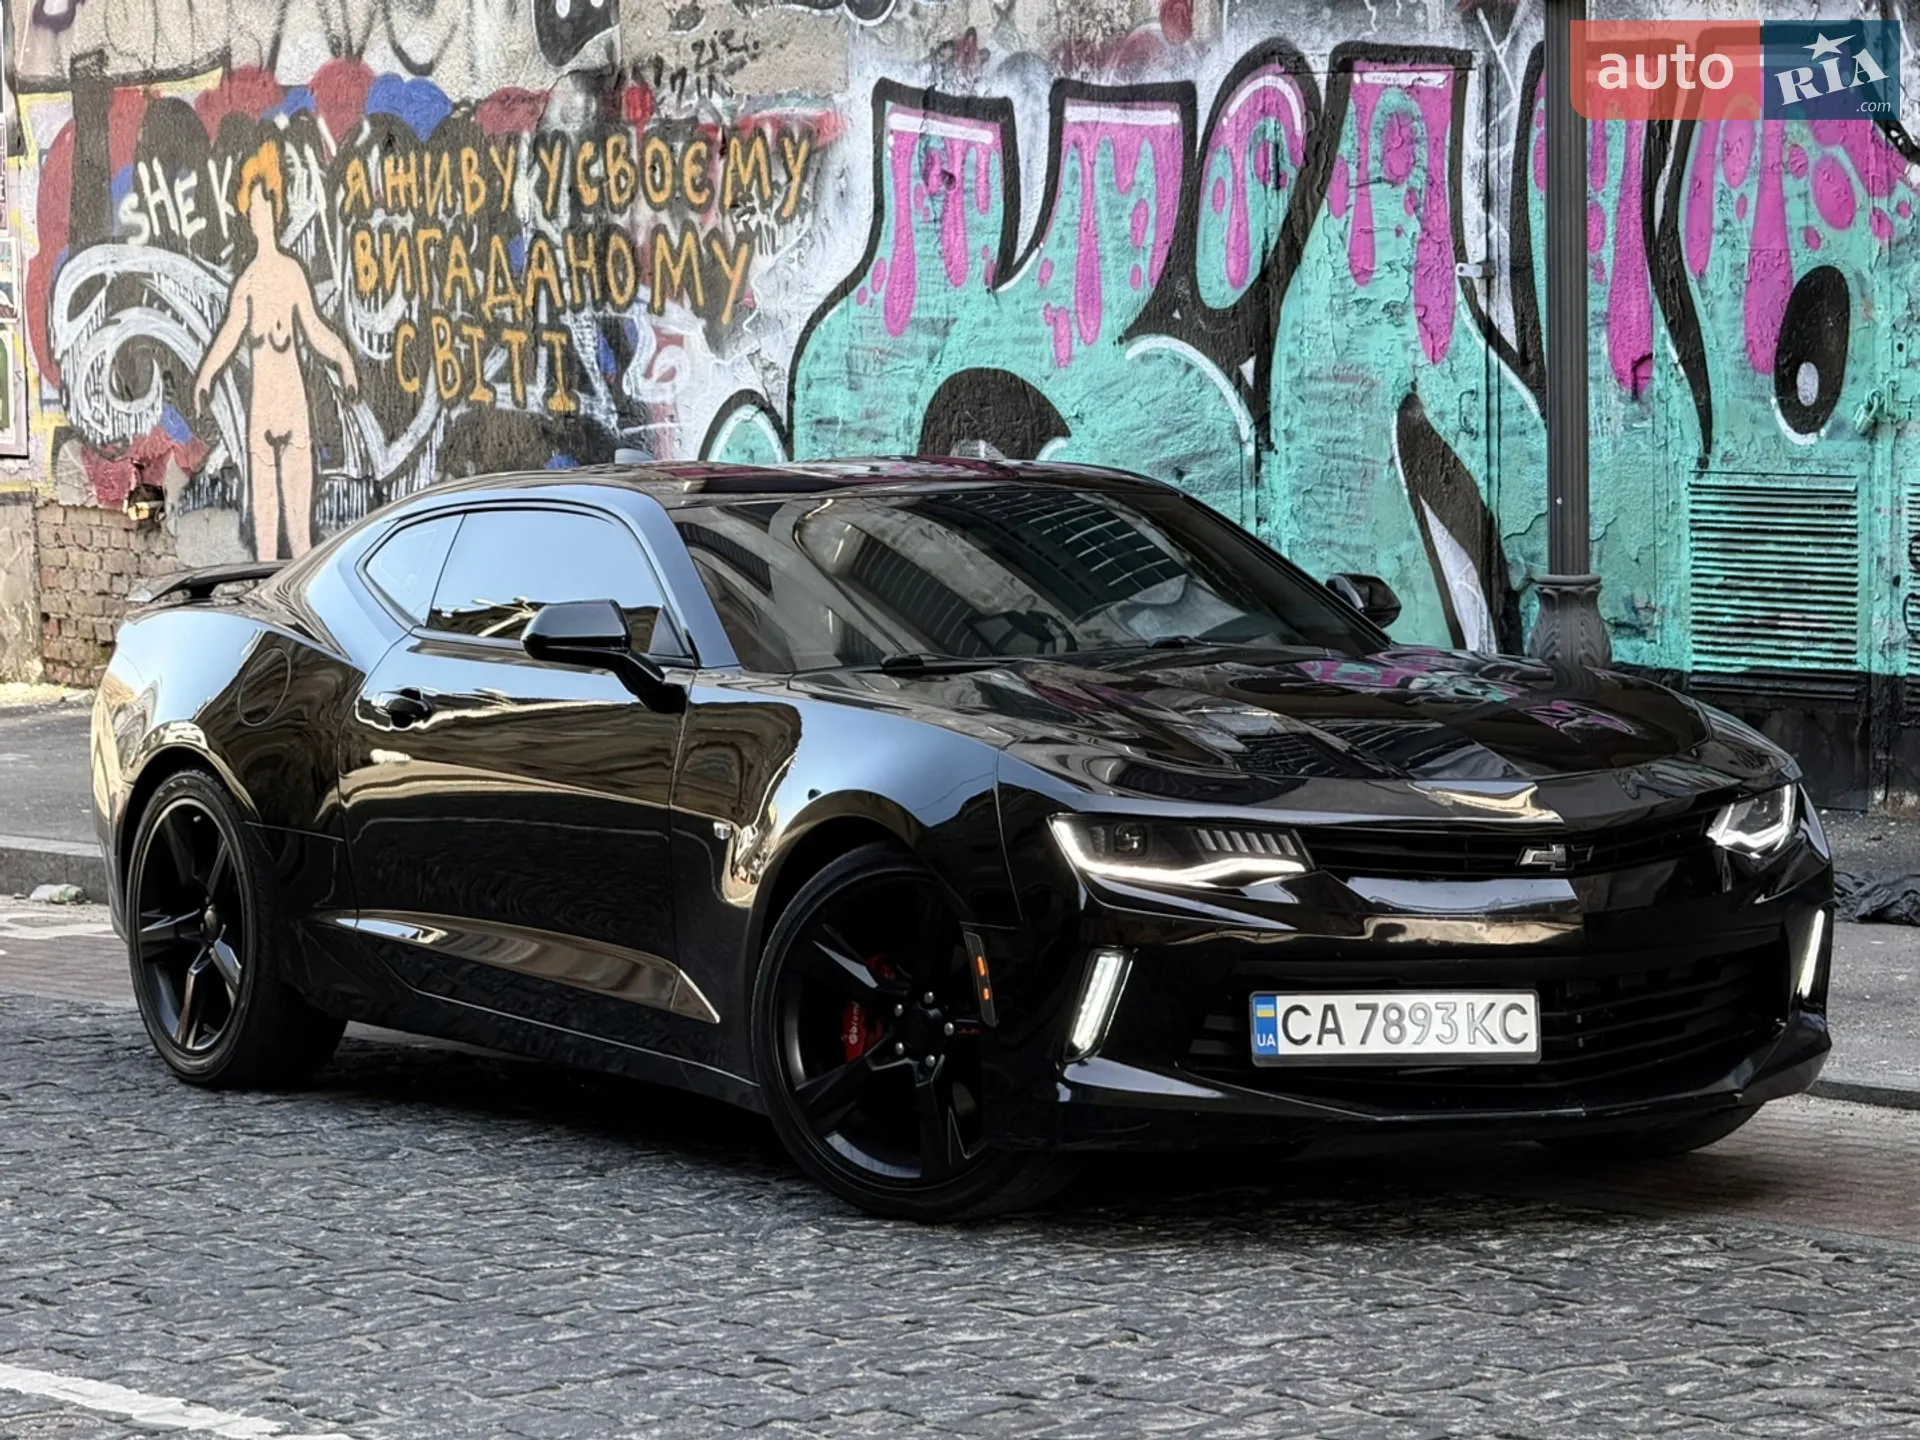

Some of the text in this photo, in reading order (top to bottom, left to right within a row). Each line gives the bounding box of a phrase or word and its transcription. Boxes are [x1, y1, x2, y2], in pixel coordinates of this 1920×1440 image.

[353, 228, 750, 326] ВИГАДАНОМУ
[395, 315, 577, 412] СВІТІ
[1256, 1033, 1277, 1047] UA
[1281, 1002, 1529, 1046] CA 7893 KC
